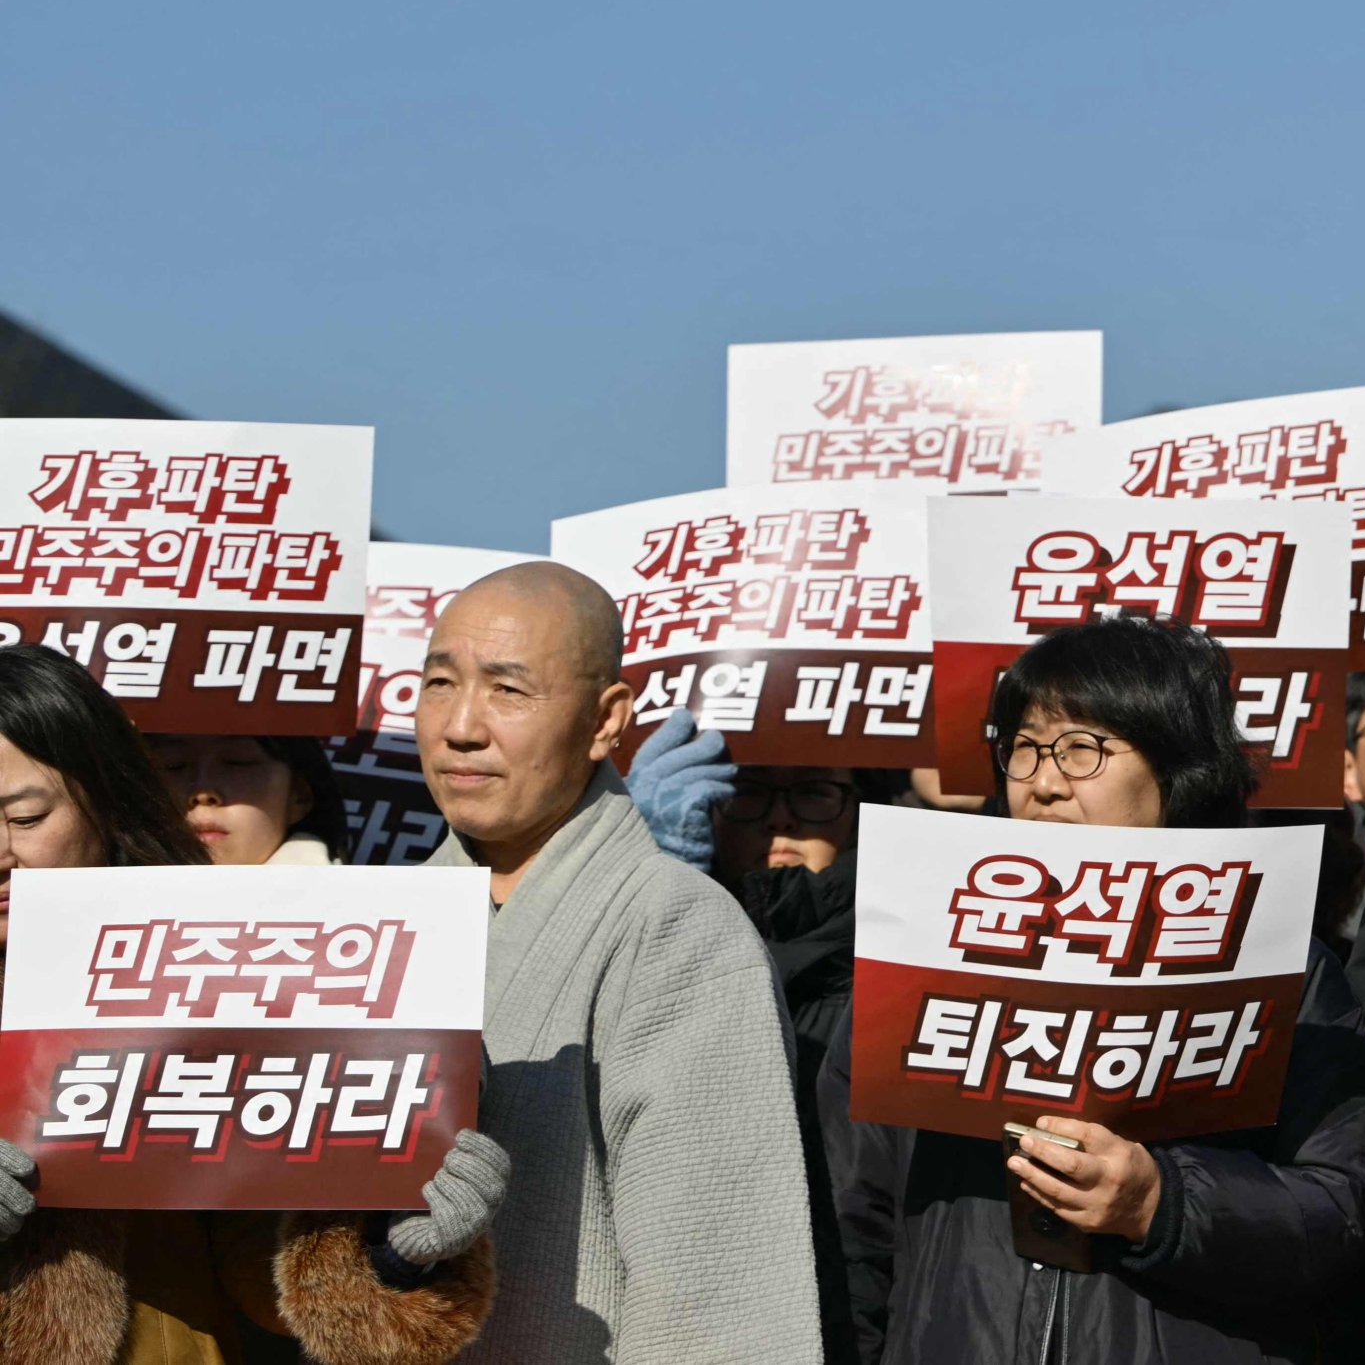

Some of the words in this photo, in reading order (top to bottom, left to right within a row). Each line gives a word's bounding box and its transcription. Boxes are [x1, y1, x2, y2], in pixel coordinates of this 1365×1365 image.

[28, 450, 157, 523] 기후
[157, 452, 292, 525] 파탄
[771, 423, 967, 484] 민주주의
[1121, 433, 1234, 497] 기후
[1226, 419, 1347, 491] 파탄
[209, 529, 344, 602] 파탄
[633, 513, 748, 582] 기후
[746, 508, 872, 571] 파탄
[1011, 530, 1297, 638] 윤석열
[799, 575, 923, 640] 파탄
[193, 625, 353, 703] 파면
[784, 661, 935, 737] 파면
[948, 854, 1264, 977] 윤석열
[86, 918, 417, 1019] 민주주의
[906, 997, 1270, 1111] 퇴진하라
[40, 1050, 442, 1163] 회복하라
